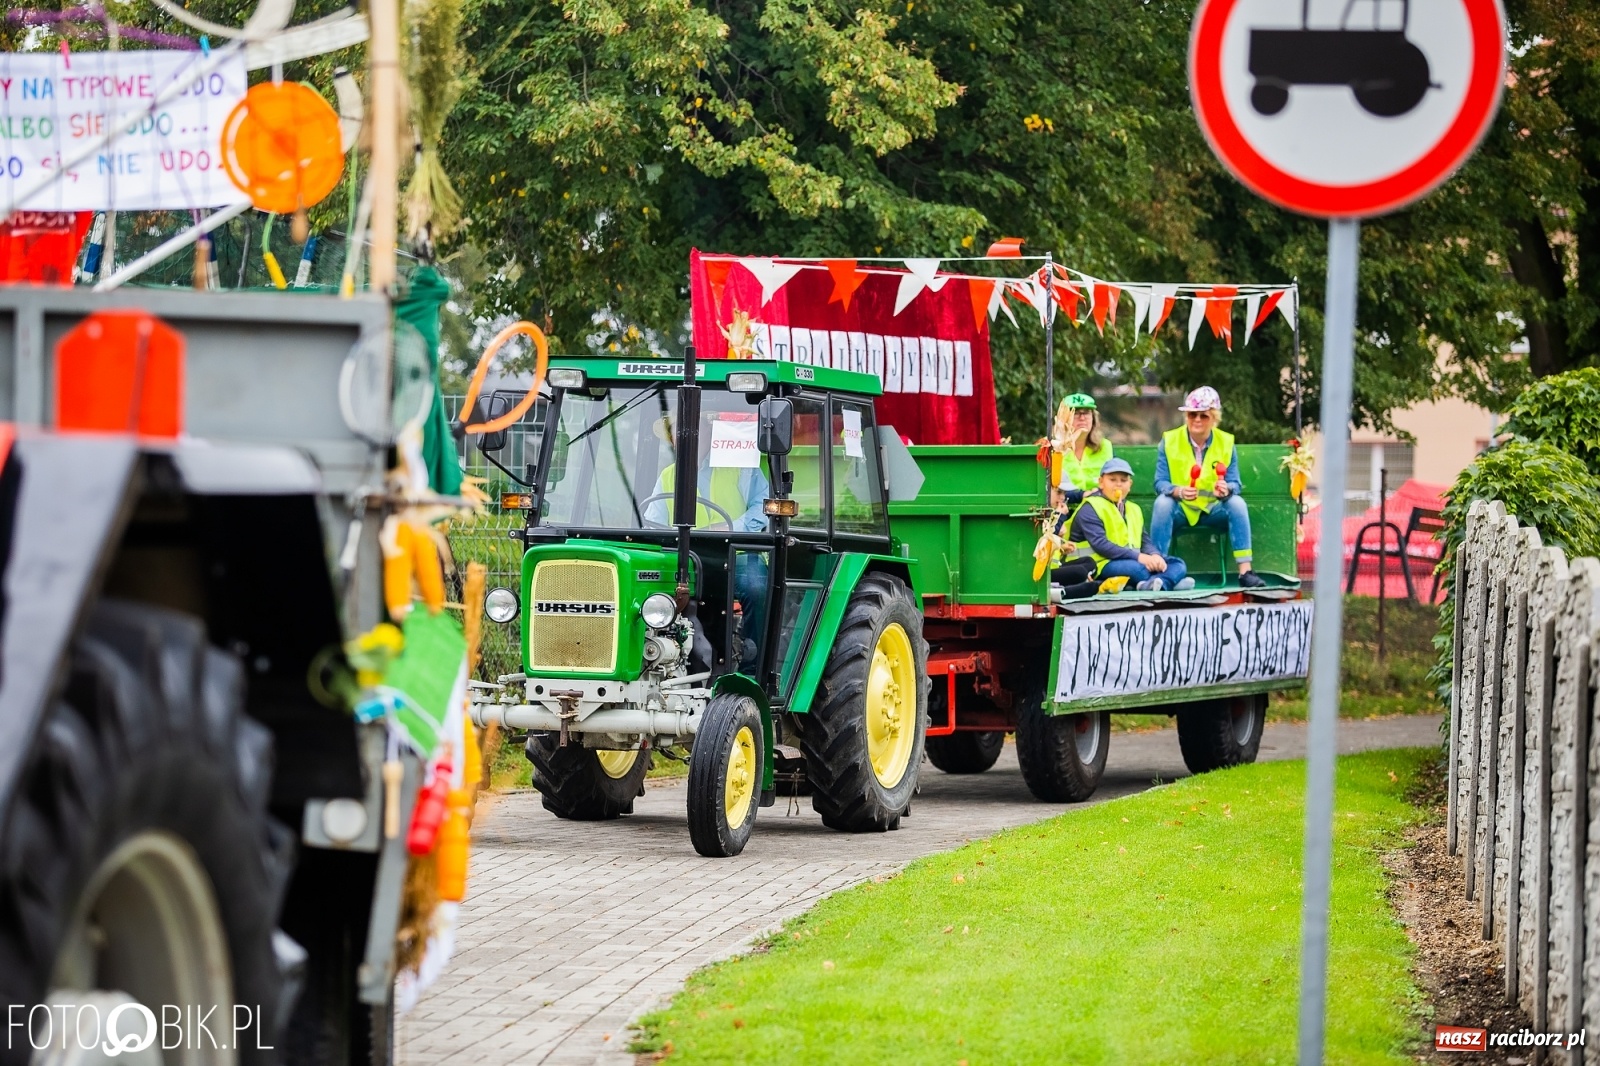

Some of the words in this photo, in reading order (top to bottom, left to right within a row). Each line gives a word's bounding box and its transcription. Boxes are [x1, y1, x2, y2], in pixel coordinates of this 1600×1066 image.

[23, 77, 53, 100] NA
[63, 75, 154, 98] TYPOWE
[174, 73, 224, 96] DO
[98, 153, 142, 175] NIE
[624, 364, 697, 374] URSU
[712, 440, 757, 449] STRAJK
[537, 602, 613, 614] URSUS
[1087, 624, 1102, 687] W
[1102, 615, 1146, 690] TYM
[1148, 614, 1199, 688] ROKU
[1196, 612, 1231, 684] NIE
